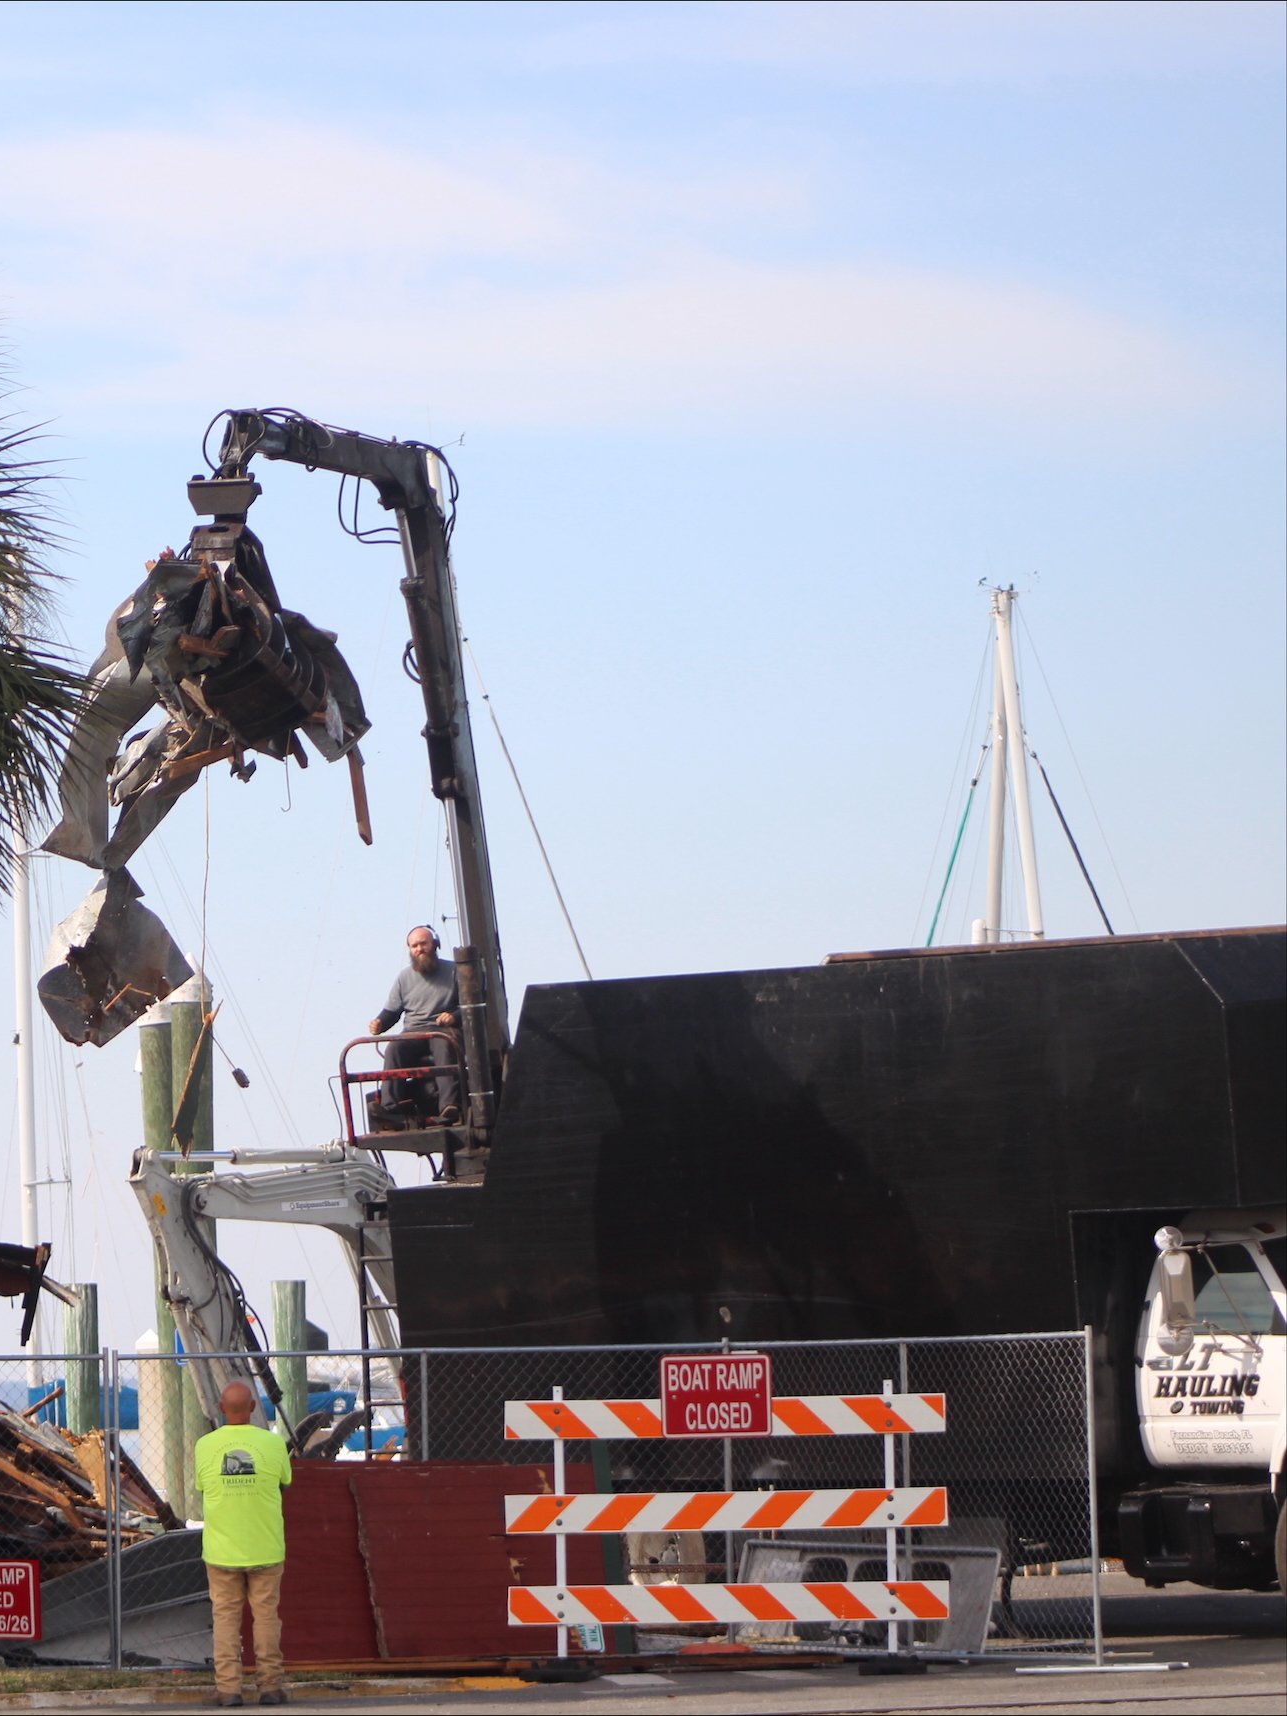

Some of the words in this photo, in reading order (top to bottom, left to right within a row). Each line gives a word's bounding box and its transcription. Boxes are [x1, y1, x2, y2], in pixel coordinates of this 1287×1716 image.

[667, 1363, 712, 1391] BOAT
[716, 1362, 764, 1390] RAMP
[1154, 1373, 1261, 1398] HAULING
[685, 1401, 752, 1430] CLOSED
[1190, 1400, 1245, 1415] TOWING
[1170, 1430, 1213, 1440] Fernandina
[1175, 1442, 1208, 1454] USDOT
